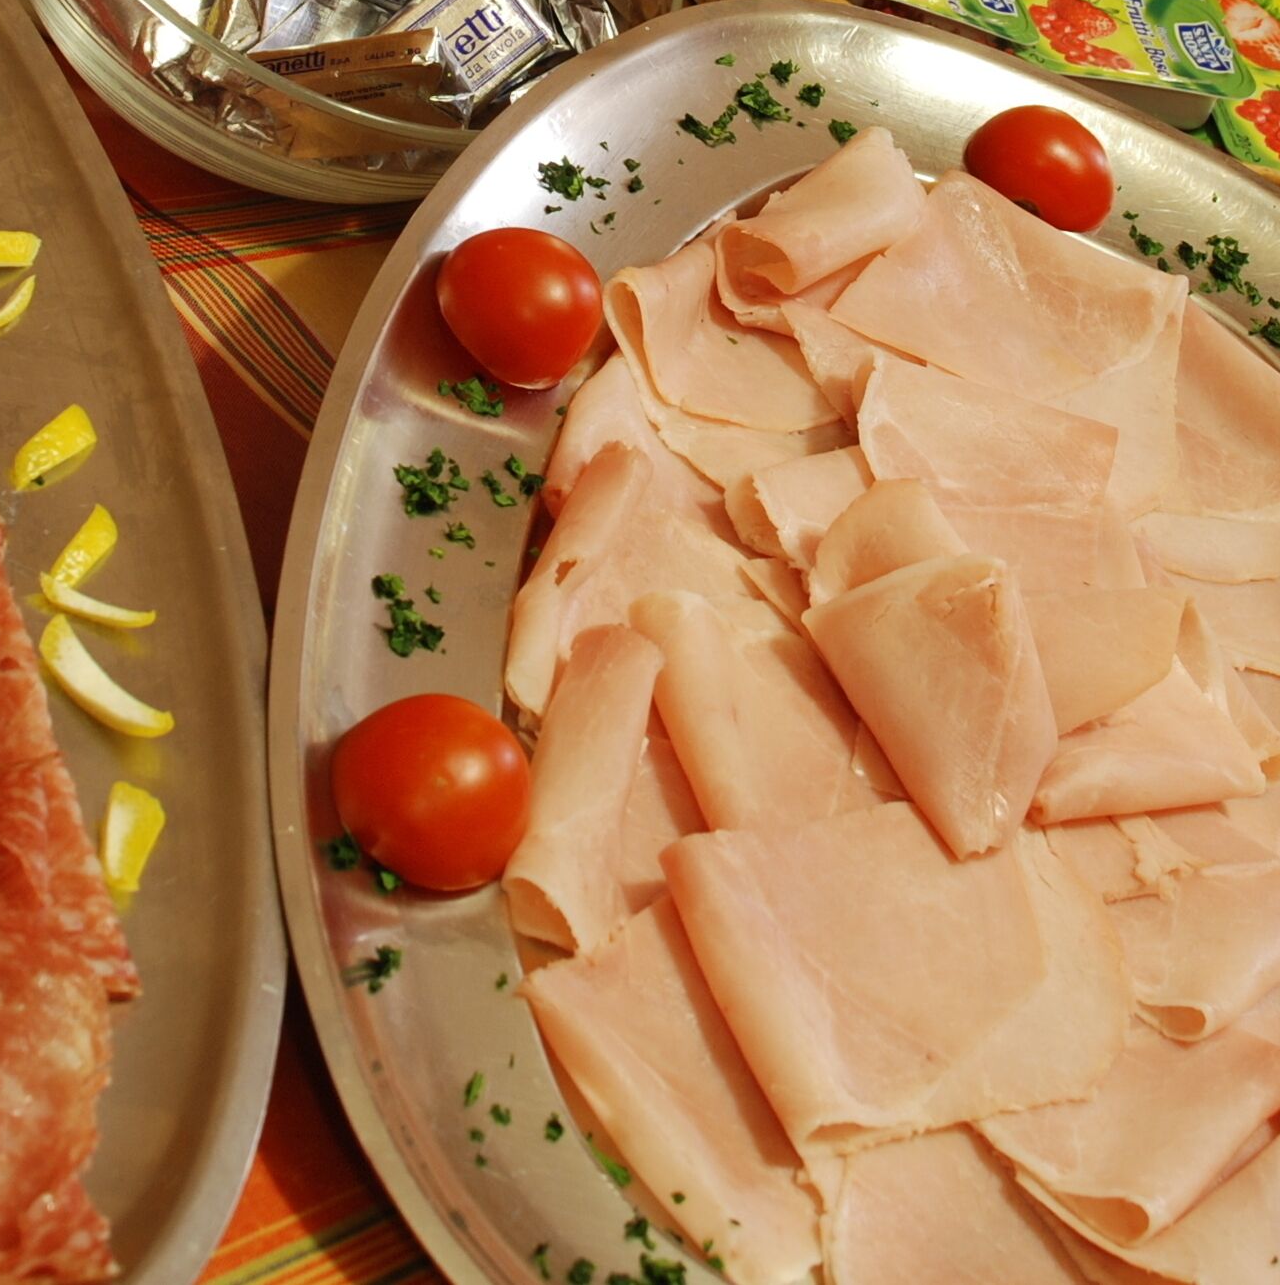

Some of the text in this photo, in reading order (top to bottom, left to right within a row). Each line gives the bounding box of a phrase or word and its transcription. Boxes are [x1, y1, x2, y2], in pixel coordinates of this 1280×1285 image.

[455, 6, 505, 56] etti
[1181, 30, 1205, 64] ROSA
[1192, 27, 1221, 69] SANTA
[265, 50, 326, 74] anetti
[465, 29, 526, 79] da tavola
